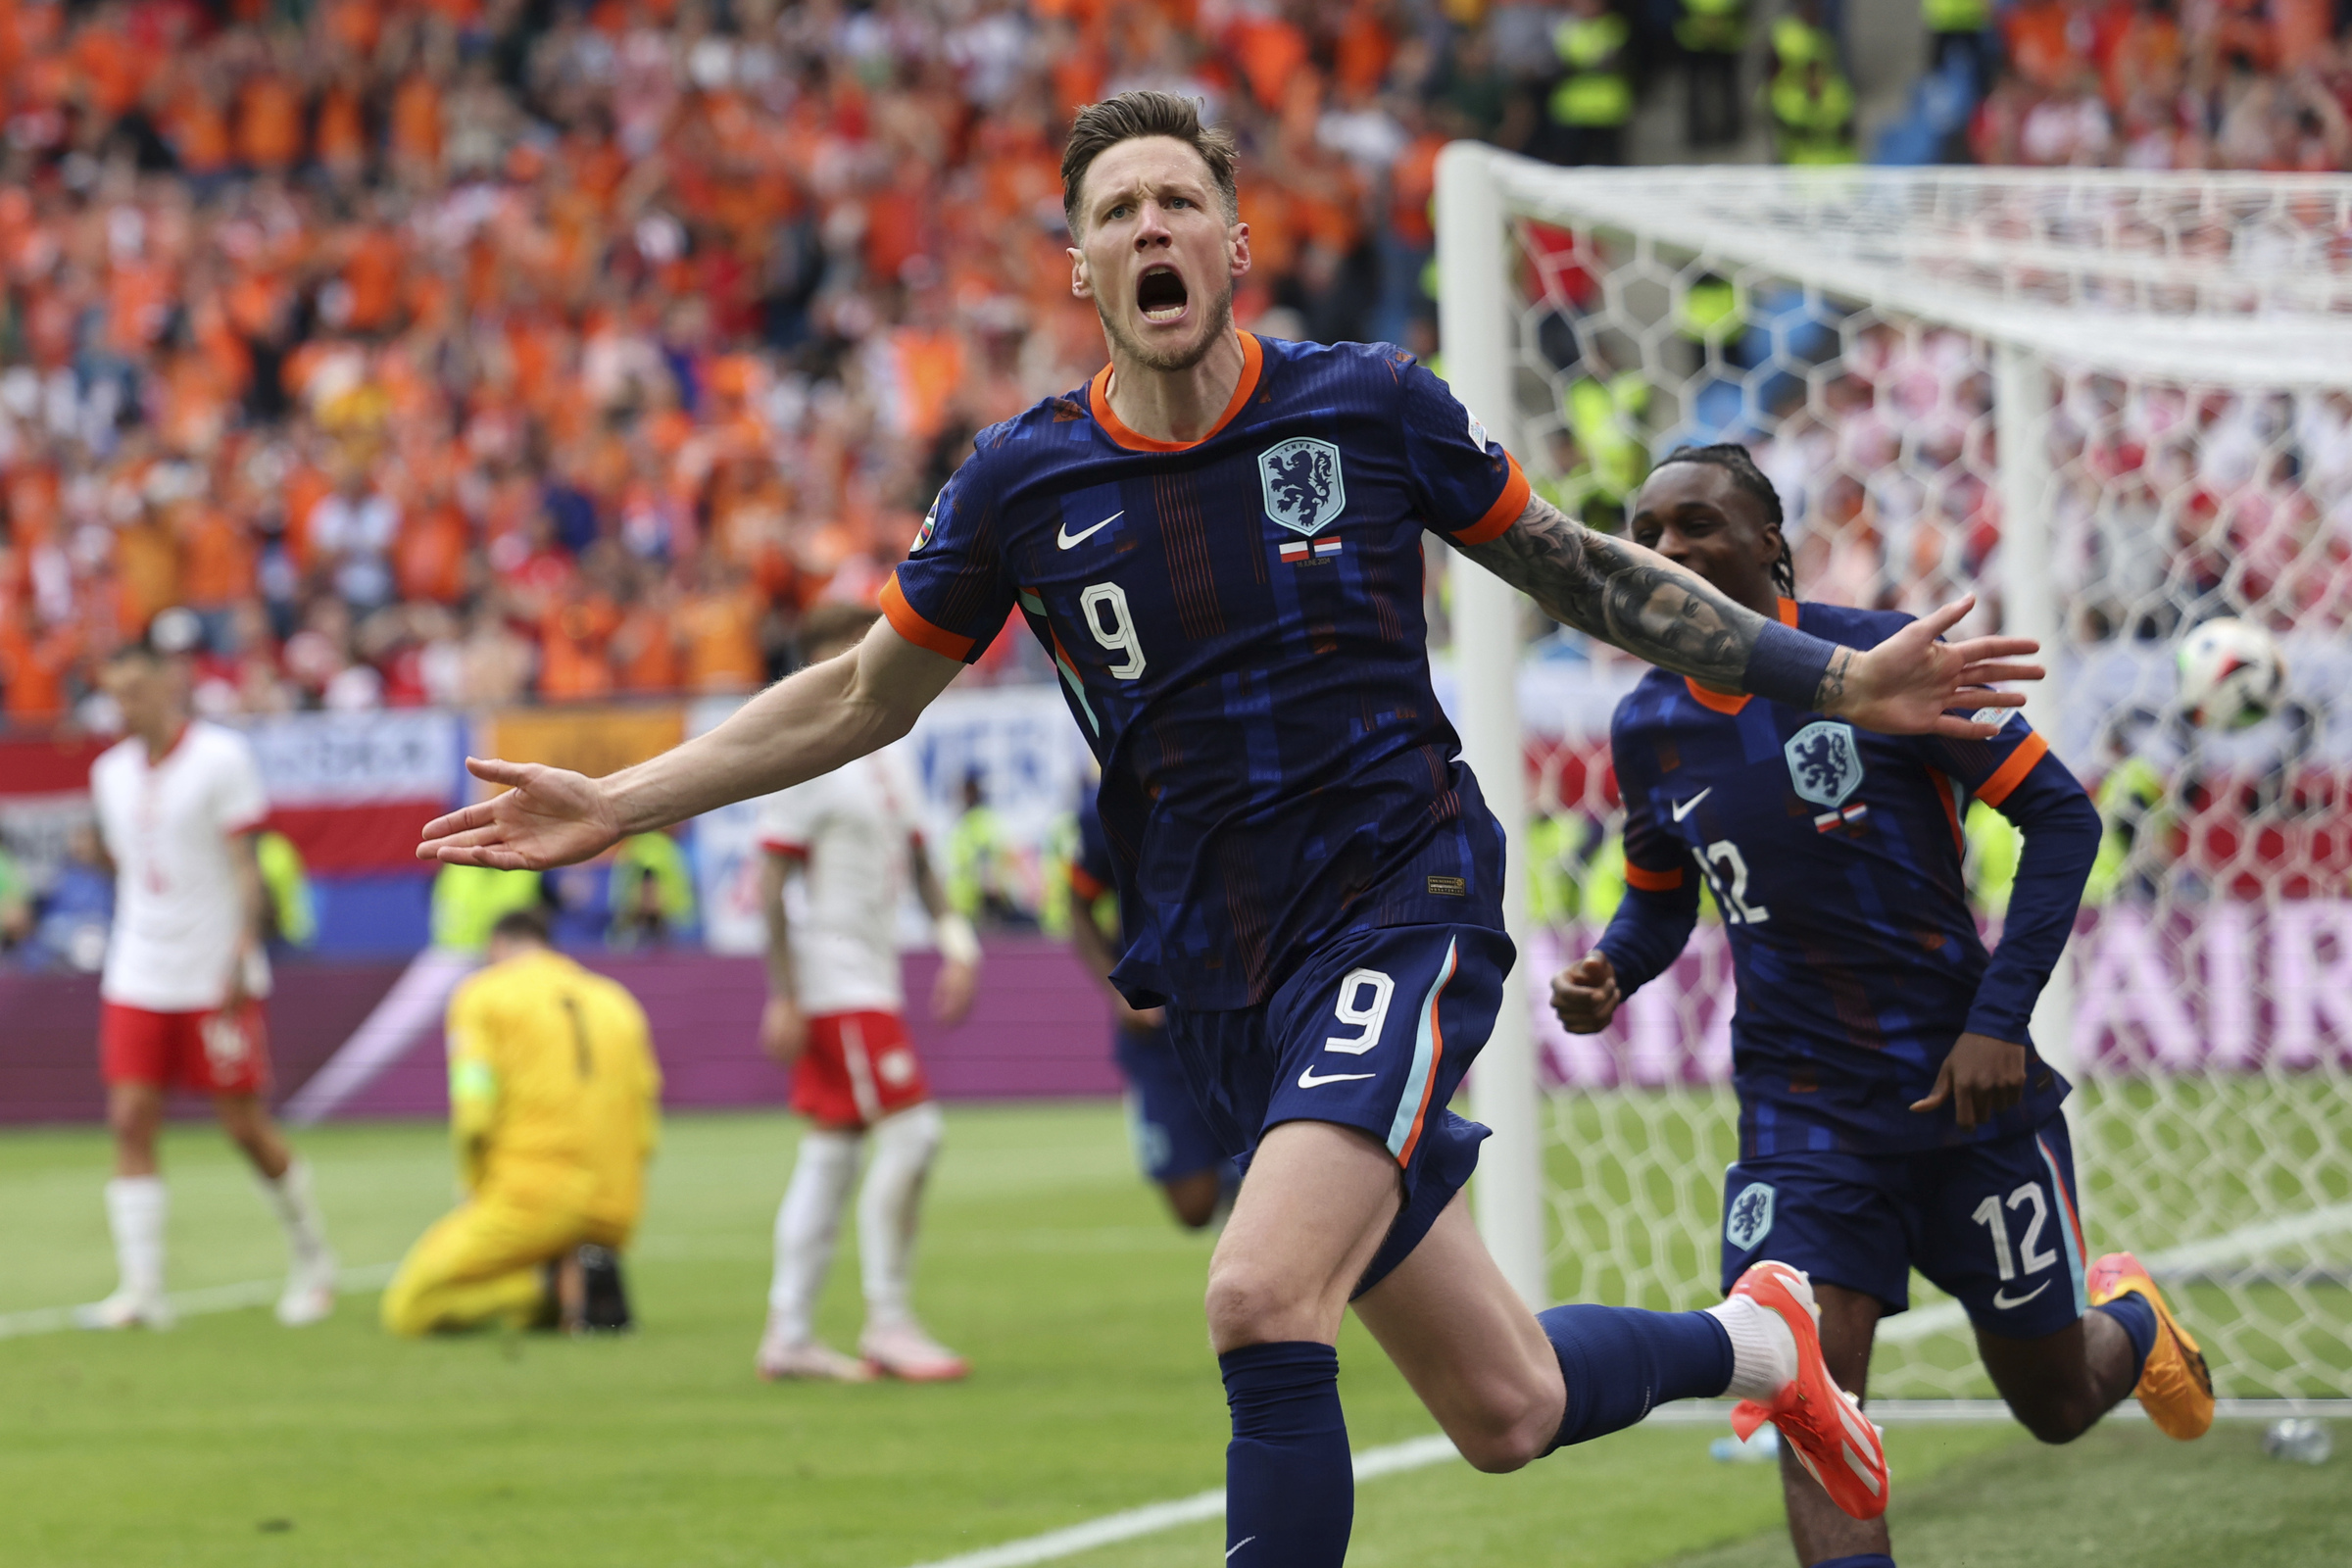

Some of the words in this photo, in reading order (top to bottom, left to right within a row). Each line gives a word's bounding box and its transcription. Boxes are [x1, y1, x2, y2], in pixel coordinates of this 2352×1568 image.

[1284, 443, 1311, 453] KNVB
[1304, 558, 1317, 567] JUNE
[1317, 557, 1331, 565] 2024
[1080, 581, 1147, 679] 9
[1691, 839, 1770, 924] 12
[560, 994, 595, 1082] 1
[1324, 966, 1396, 1055] 9
[1971, 1181, 2057, 1281] 12
